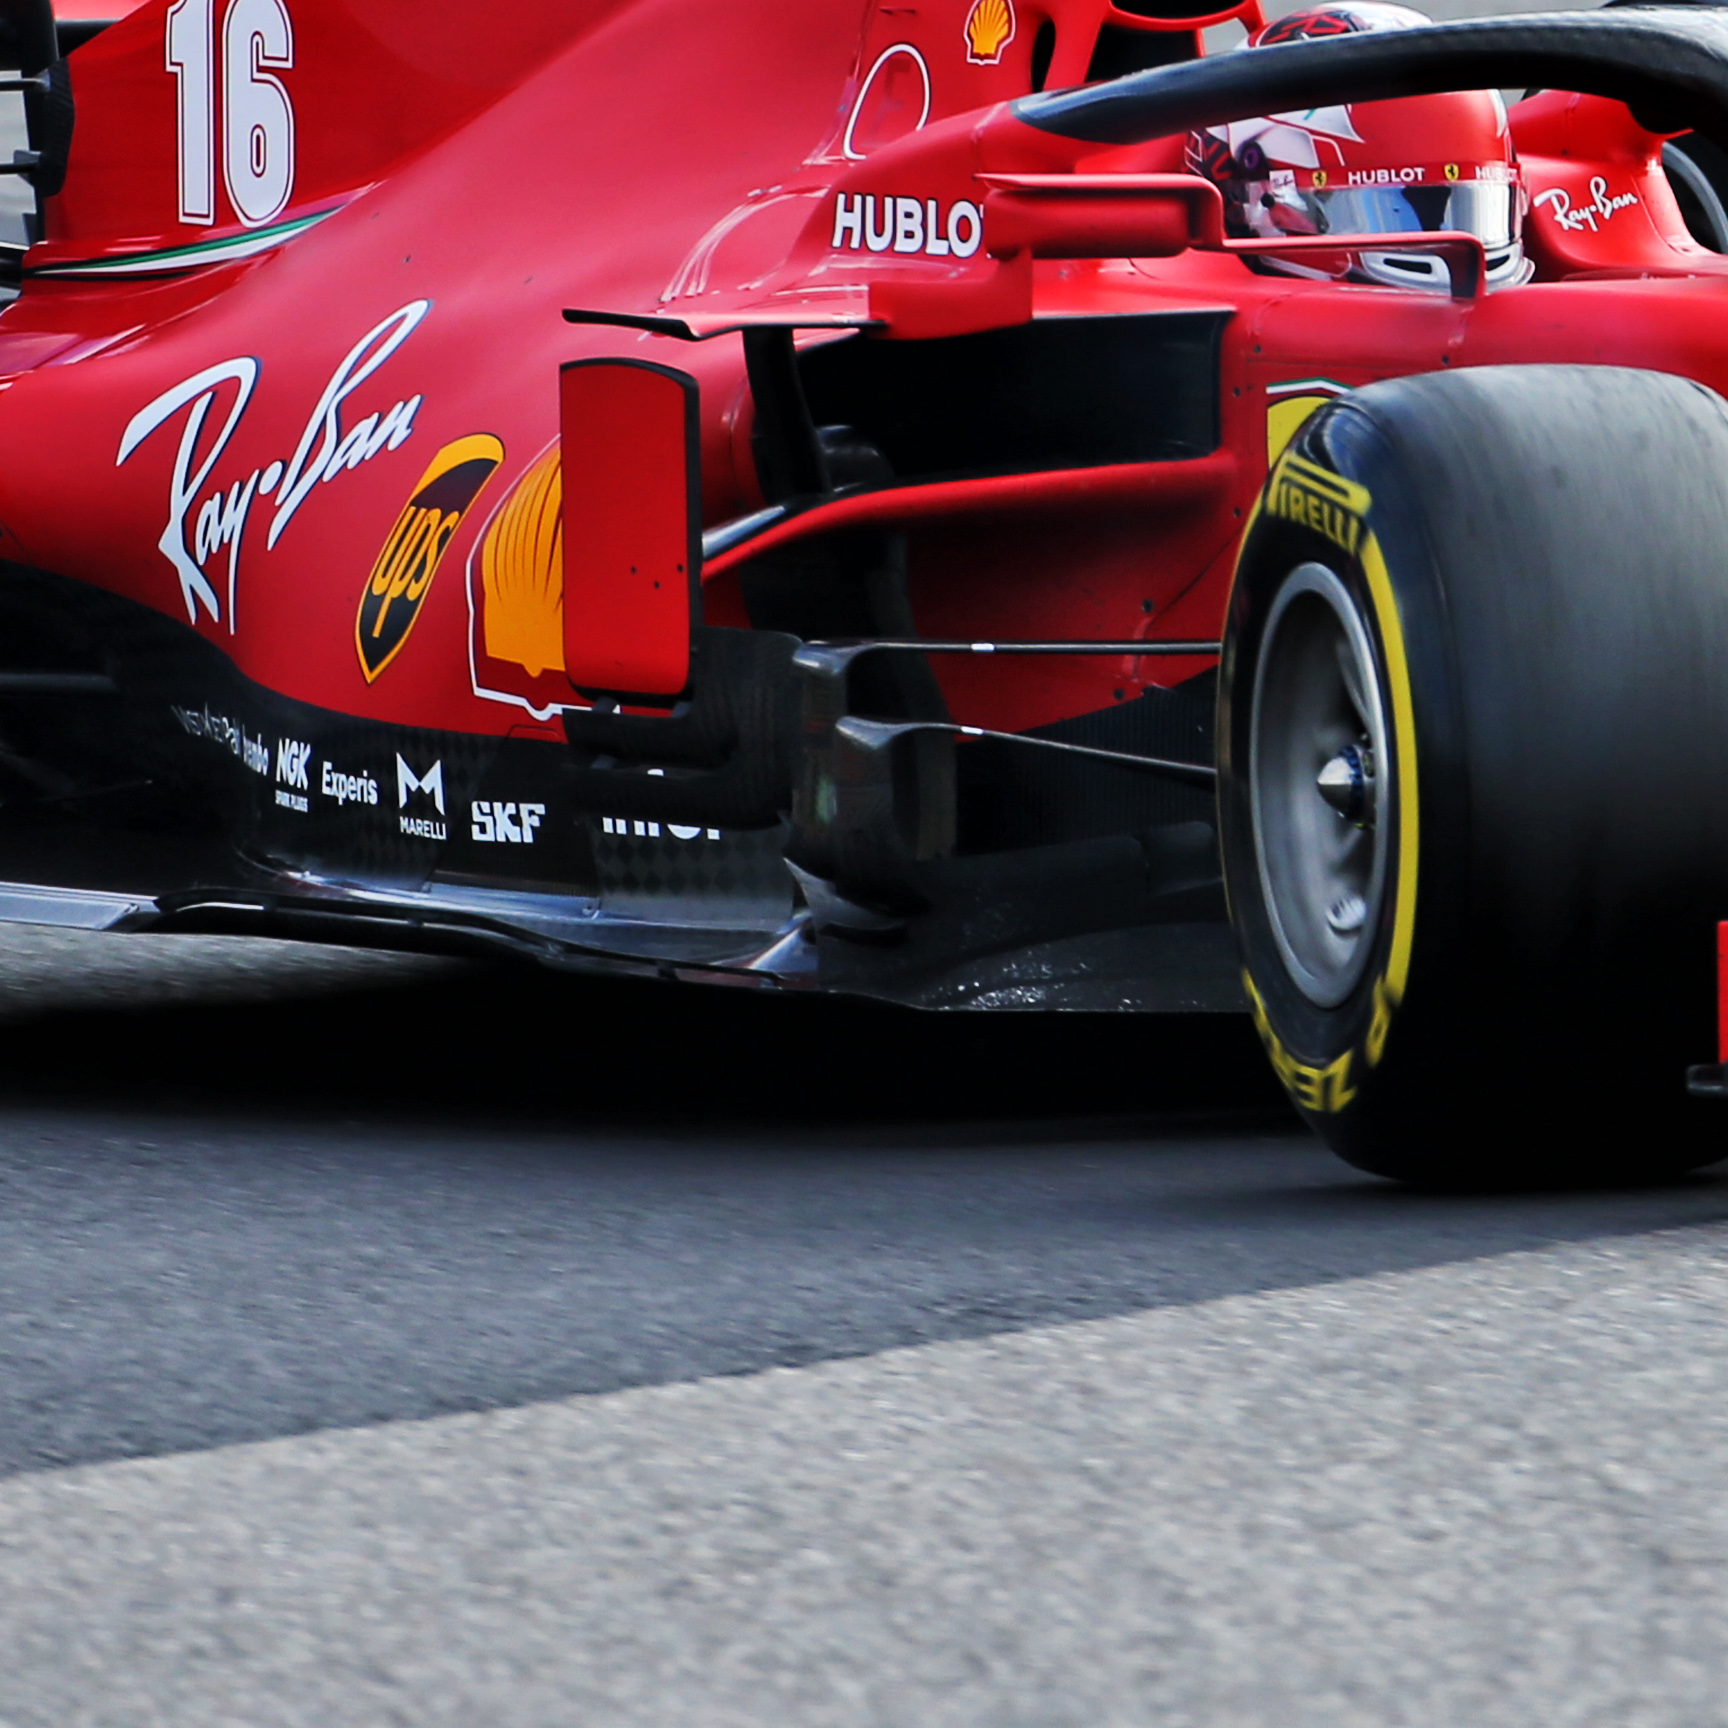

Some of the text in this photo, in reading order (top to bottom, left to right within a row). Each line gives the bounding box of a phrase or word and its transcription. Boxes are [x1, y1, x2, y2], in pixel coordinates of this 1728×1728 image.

[1347, 167, 1426, 186] HUBLOT
[1533, 175, 1639, 232] Ray-Ban
[830, 191, 986, 259] HUBLO
[115, 298, 434, 636] Ray-Ban
[1266, 451, 1372, 557] PIRELLI
[371, 505, 460, 638] ups
[275, 737, 311, 791] NGK
[321, 760, 379, 807] Experis
[399, 815, 448, 841] MARELLI
[471, 800, 546, 843] SKF
